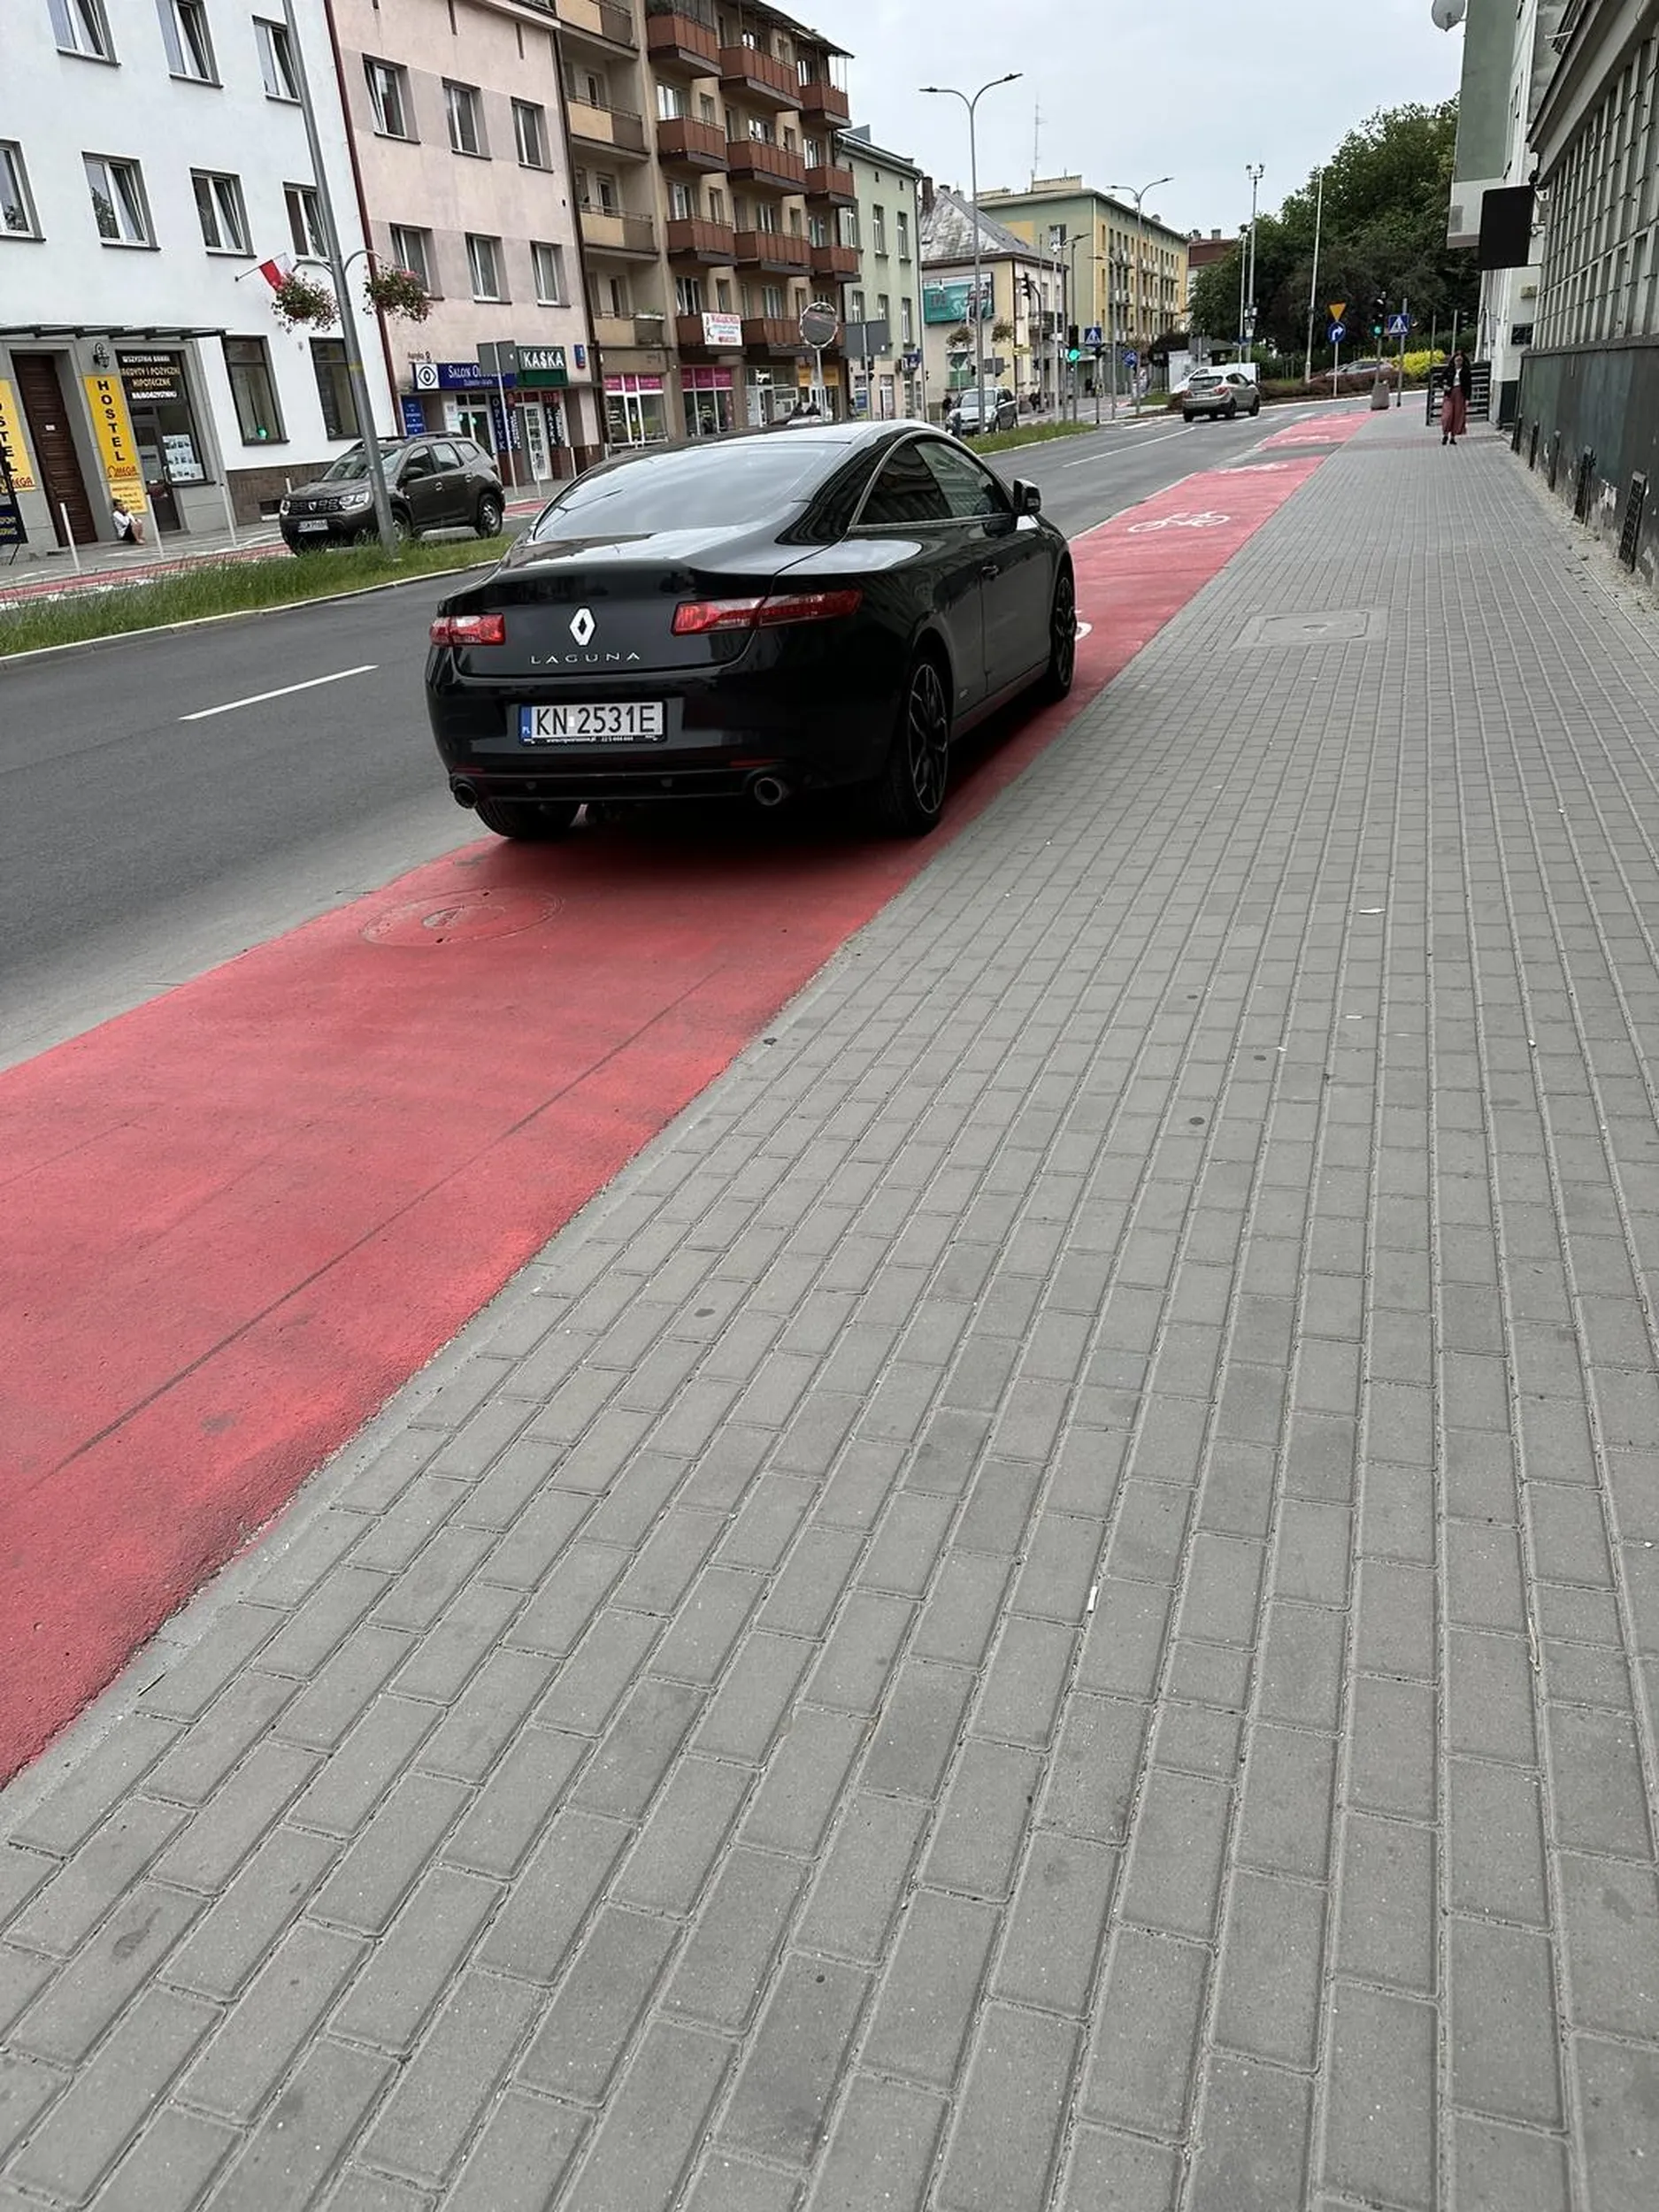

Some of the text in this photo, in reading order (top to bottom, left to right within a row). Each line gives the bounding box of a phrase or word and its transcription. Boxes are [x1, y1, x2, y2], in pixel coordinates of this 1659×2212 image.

[97, 380, 126, 462] HOSTEL
[531, 652, 640, 664] LAGUNA
[536, 705, 655, 735] KN 2531E
